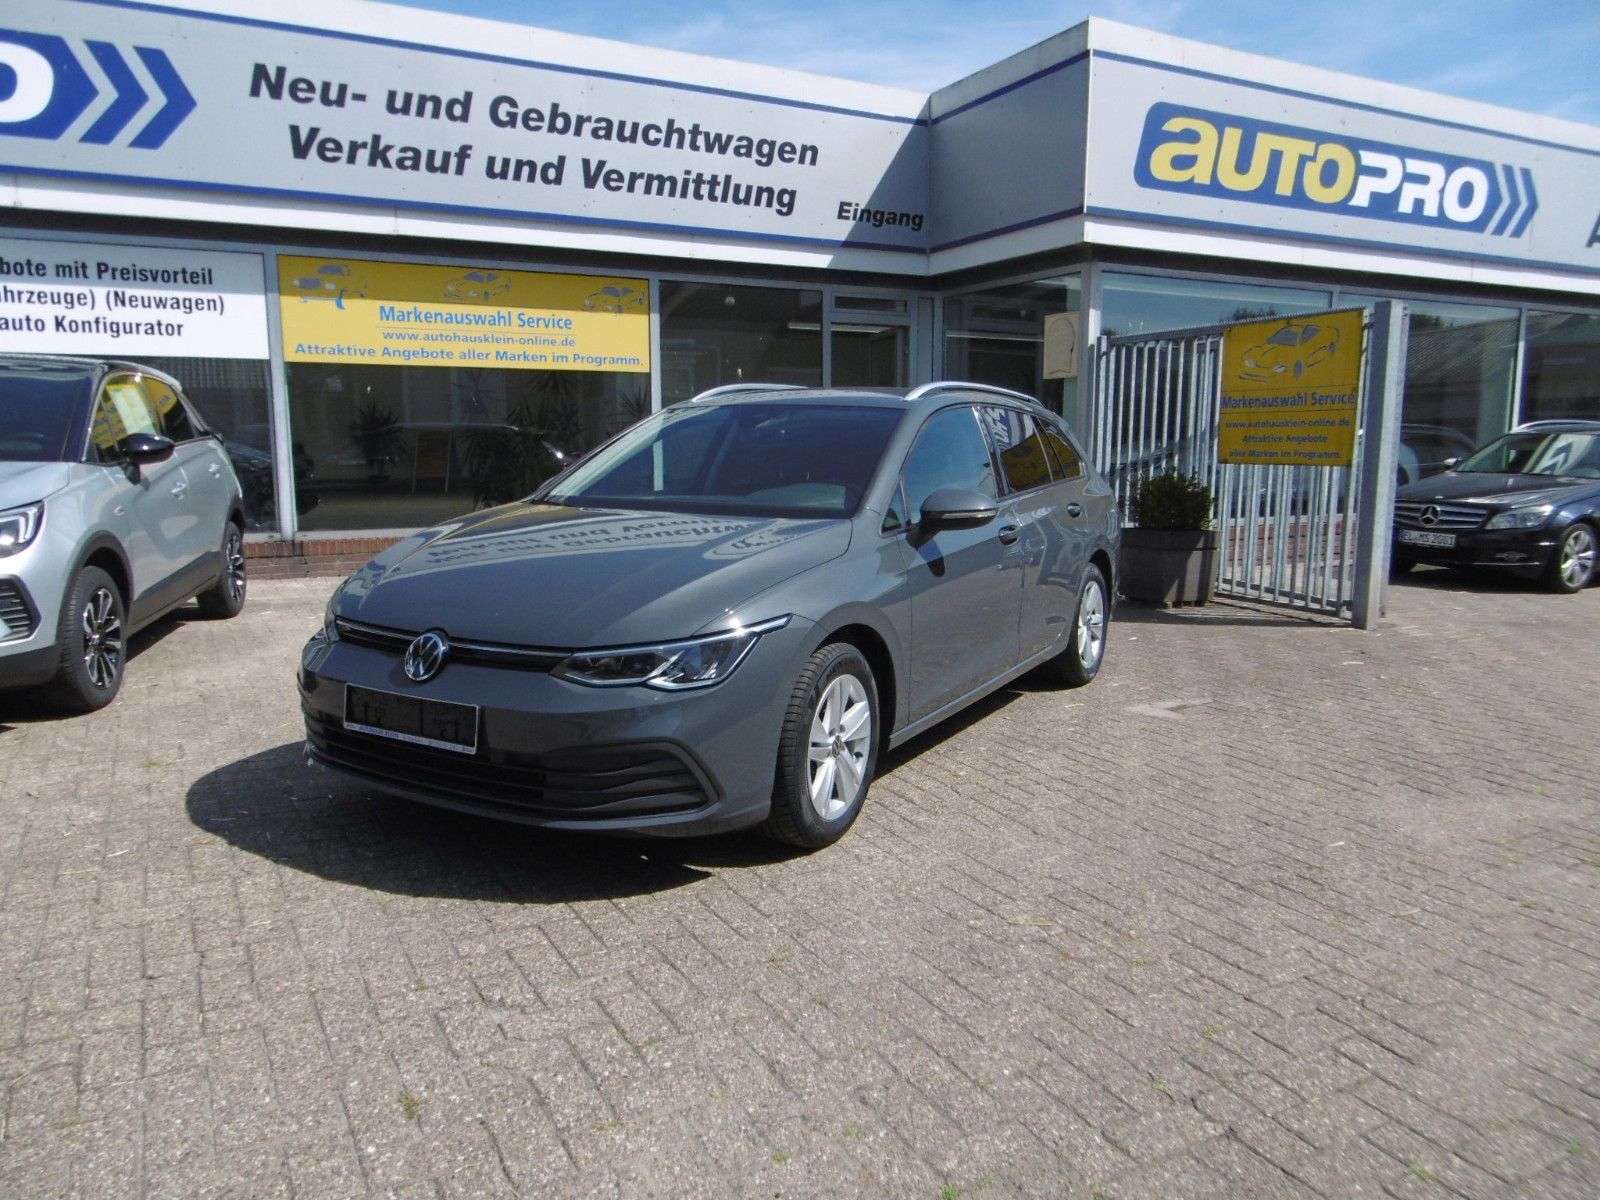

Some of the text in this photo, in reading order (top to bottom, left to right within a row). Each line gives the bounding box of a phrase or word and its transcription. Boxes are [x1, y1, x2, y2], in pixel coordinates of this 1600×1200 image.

[249, 62, 819, 168] Neu- und Gebrauchtwagen
[288, 124, 797, 217] Verkauf und Vermittlung
[837, 201, 924, 231] Eingang
[55, 261, 89, 279] mit
[97, 262, 214, 285] Preisvorteil
[0, 285, 225, 316] hrzeuge) (Neuwagen)
[0, 315, 184, 338] auto Konfigurator
[379, 305, 573, 330] Markenauswahl Service
[383, 331, 576, 347] www.autohausklein-online.de
[295, 342, 644, 367] Attraktive Angebote aller Marken im Programm.
[1222, 390, 1356, 409] Markenauswahl Service
[1242, 434, 1329, 445] Attraktive Angebote
